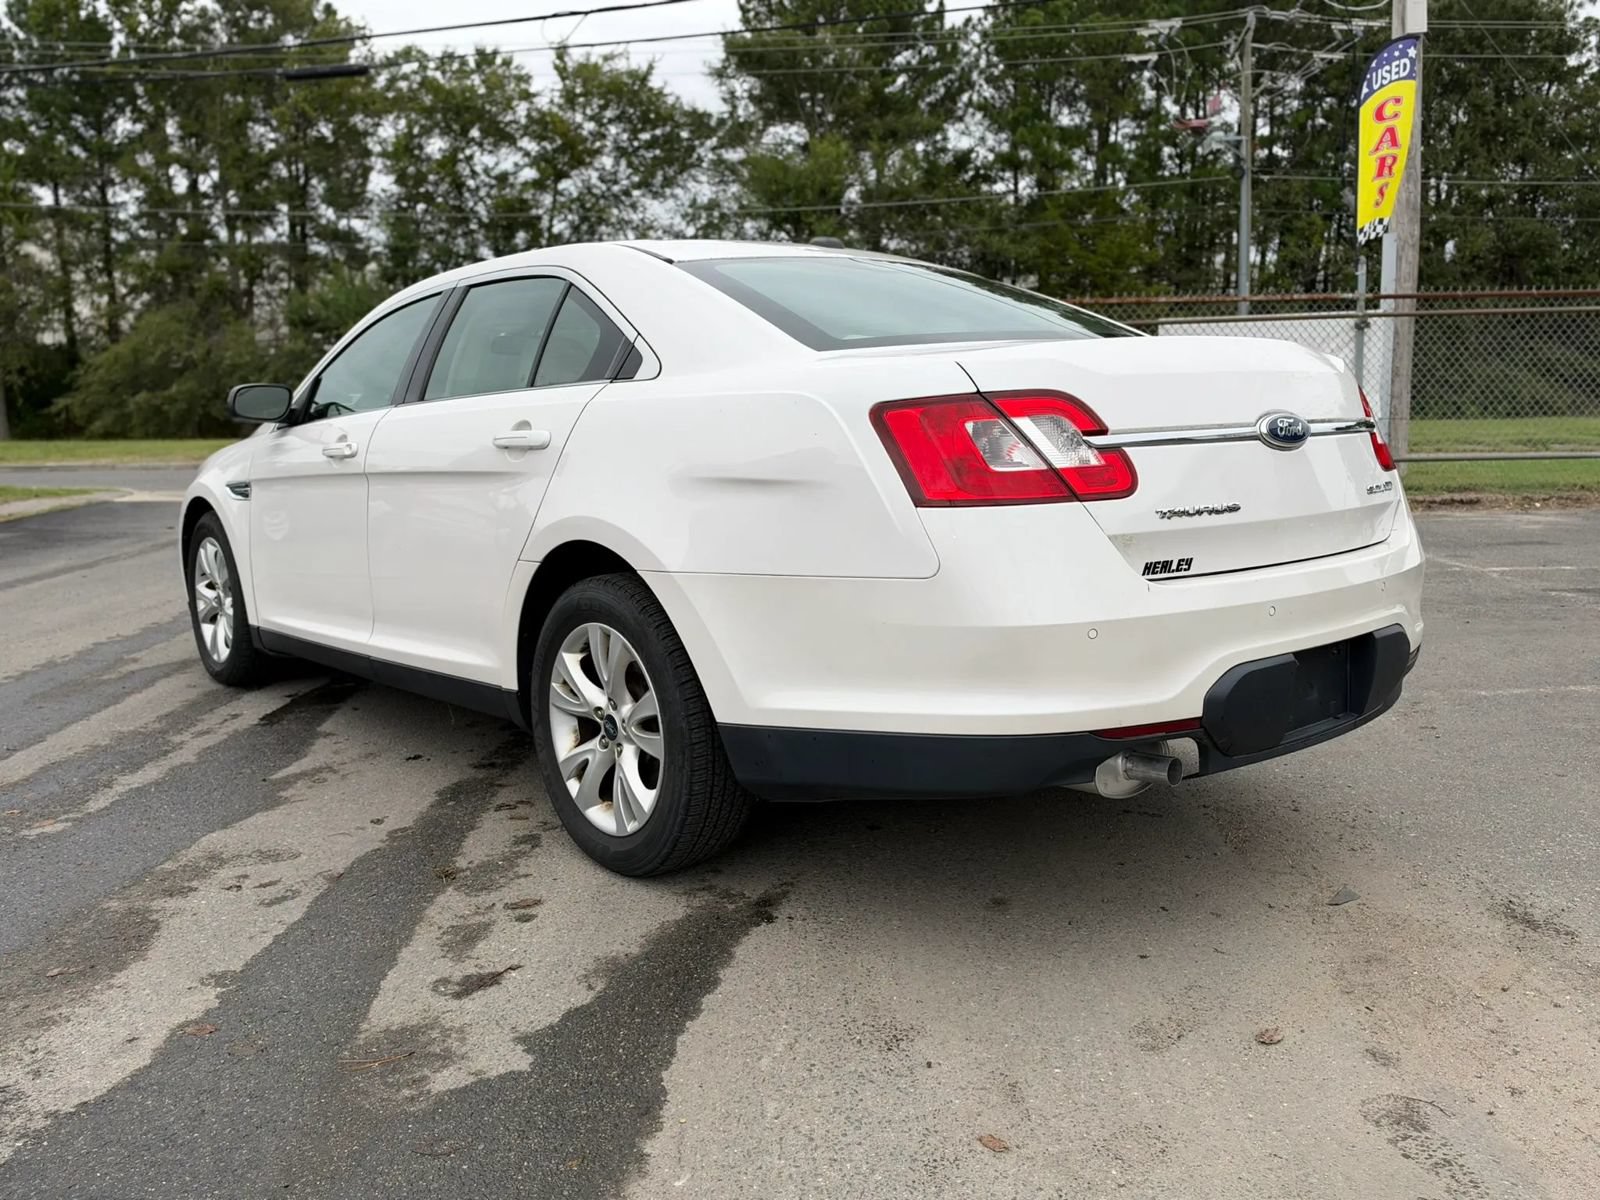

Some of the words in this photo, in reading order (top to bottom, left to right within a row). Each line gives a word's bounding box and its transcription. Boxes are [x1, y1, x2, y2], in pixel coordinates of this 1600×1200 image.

[1372, 58, 1410, 90] USED
[1369, 96, 1403, 208] CARS
[1277, 418, 1304, 437] Ford
[1155, 503, 1241, 520] TAURUS
[1141, 557, 1193, 576] HEALEY
